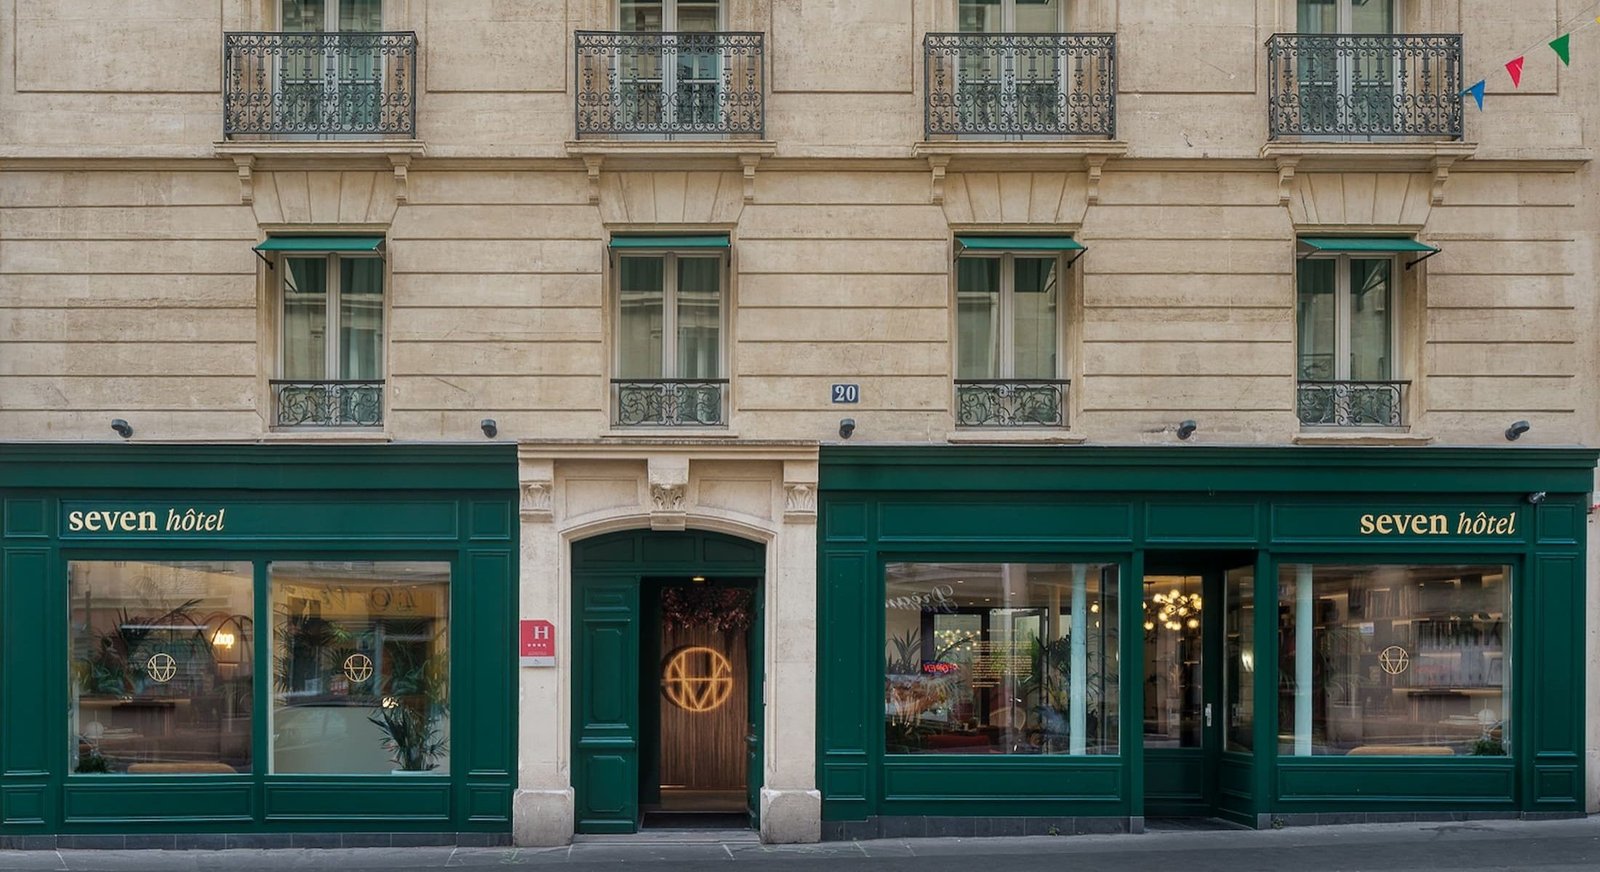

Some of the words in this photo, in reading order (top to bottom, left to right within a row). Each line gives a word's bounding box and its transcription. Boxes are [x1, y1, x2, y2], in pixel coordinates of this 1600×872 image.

[834, 385, 856, 402] 20
[69, 511, 158, 531] seven
[166, 508, 224, 531] hôtel
[1360, 514, 1449, 534] seven
[1457, 511, 1516, 535] hôtel
[534, 626, 548, 640] H
